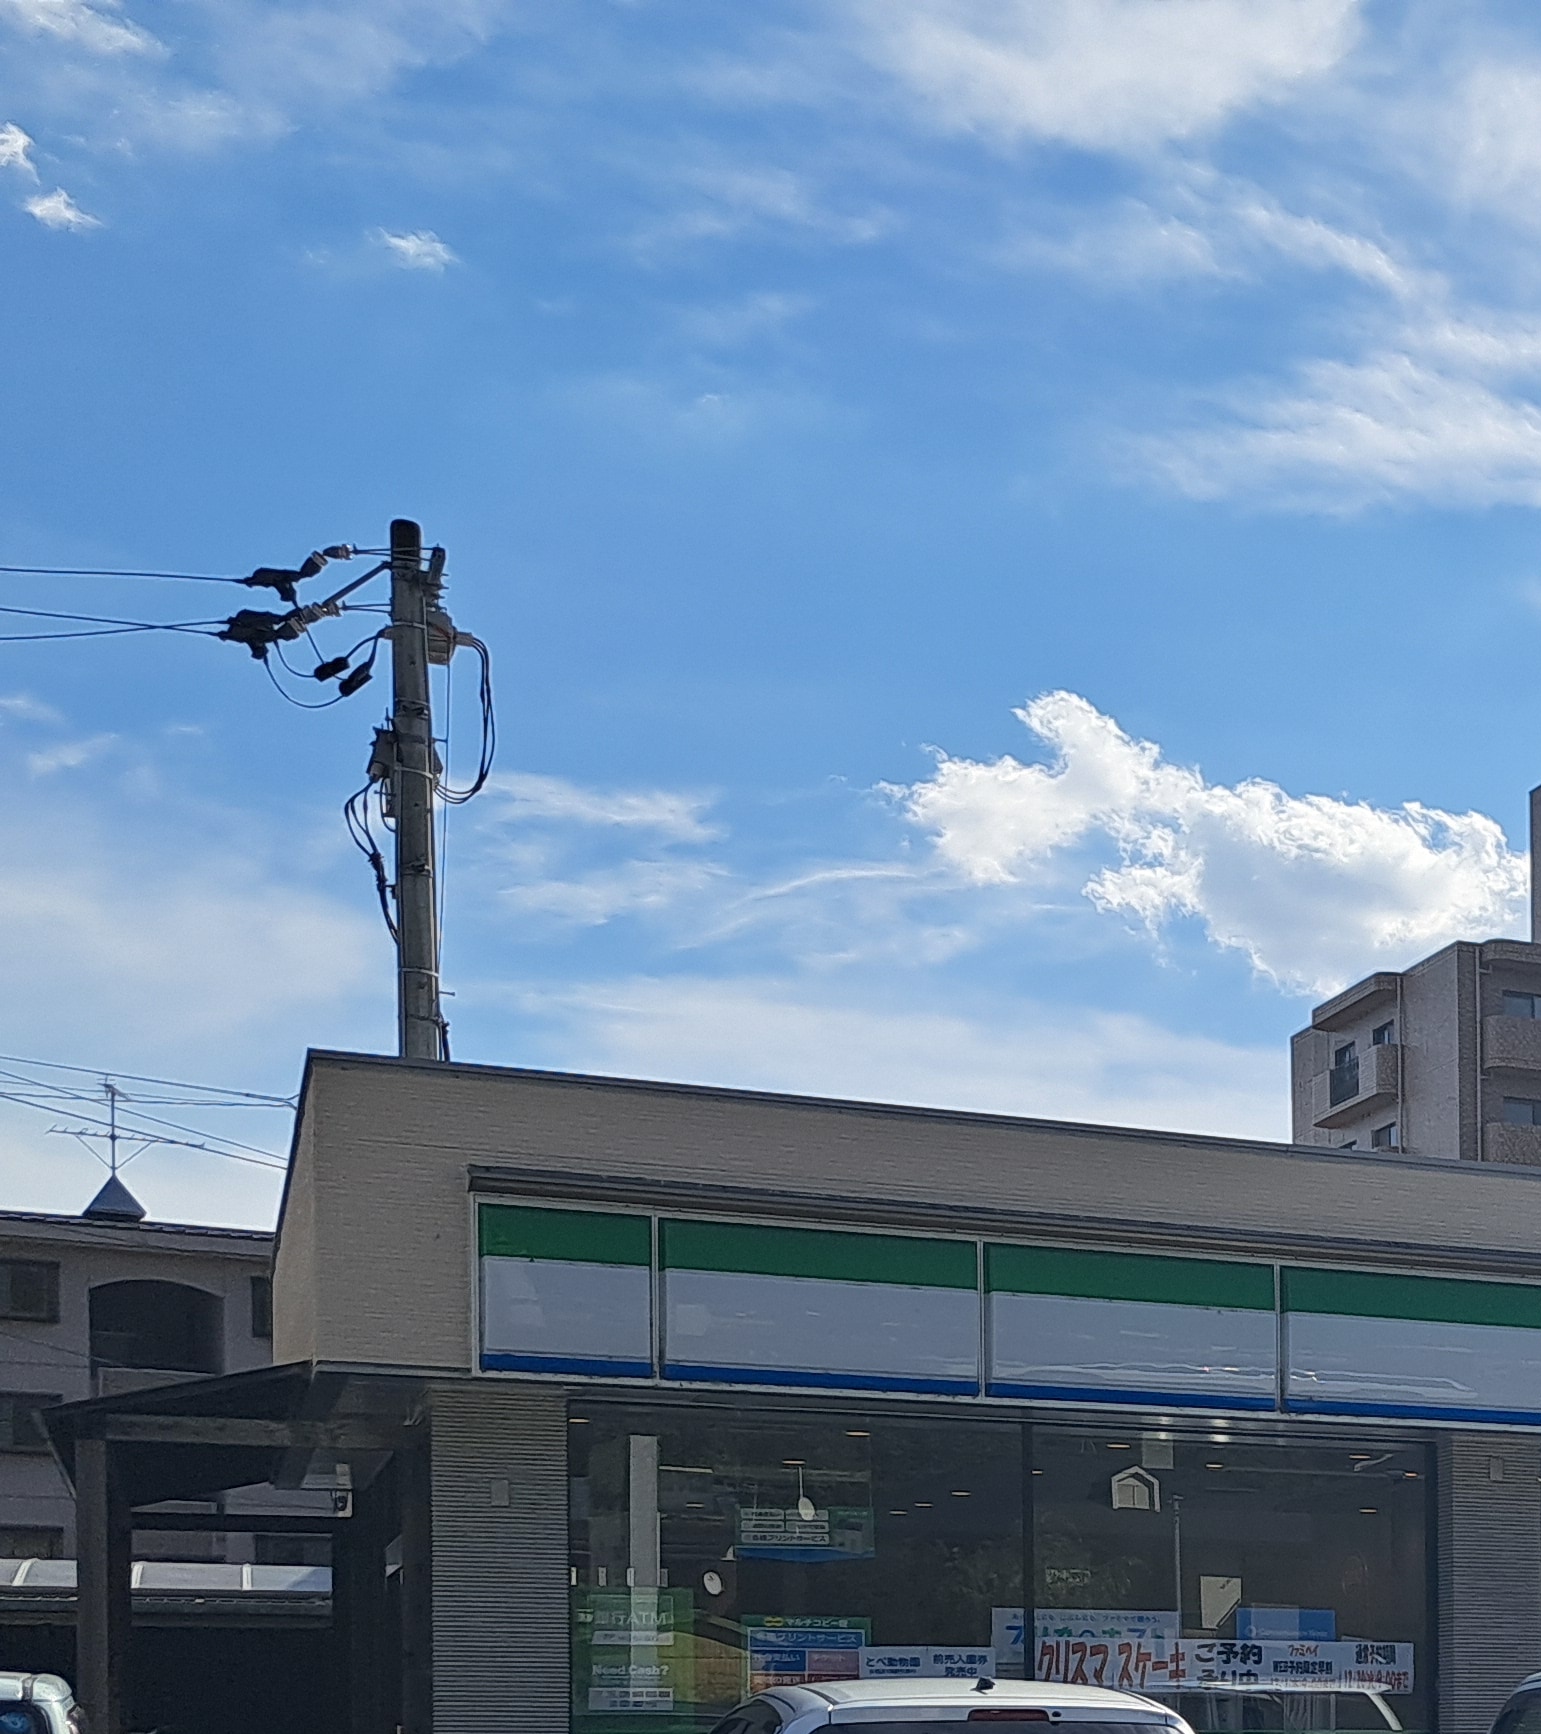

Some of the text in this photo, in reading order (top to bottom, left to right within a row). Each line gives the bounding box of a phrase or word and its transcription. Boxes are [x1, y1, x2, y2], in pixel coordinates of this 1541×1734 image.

[865, 1657, 921, 1667] とべ動物園
[1194, 1642, 1263, 1665] ご予約
[629, 1664, 670, 1676] Cash?
[1037, 1639, 1186, 1690] クリスマスケーキ
